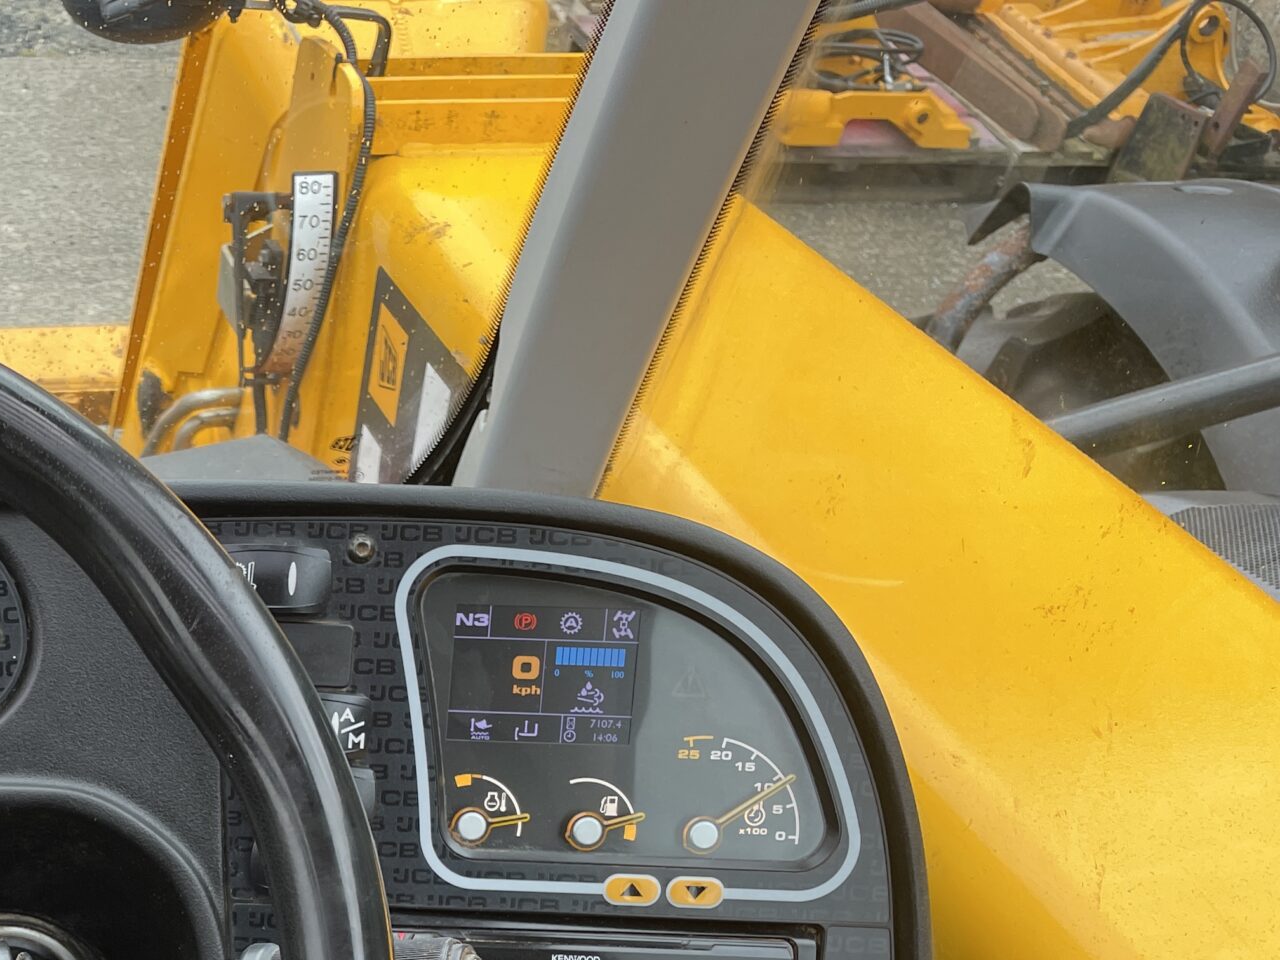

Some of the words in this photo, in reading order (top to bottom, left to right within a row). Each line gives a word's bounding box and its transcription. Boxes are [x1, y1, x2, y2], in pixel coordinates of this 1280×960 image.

[299, 181, 321, 195] 80
[298, 214, 320, 228] 70
[296, 248, 318, 261] 60
[292, 279, 313, 291] 50
[456, 613, 489, 627] N3
[611, 670, 624, 678] 100
[512, 685, 540, 696] kph
[590, 719, 622, 729] 7107.4
[593, 733, 618, 742] 14:06
[678, 750, 700, 759] 25
[710, 751, 732, 760] 20
[735, 762, 756, 772] 15
[772, 805, 783, 814] 5
[775, 831, 786, 841] 0
